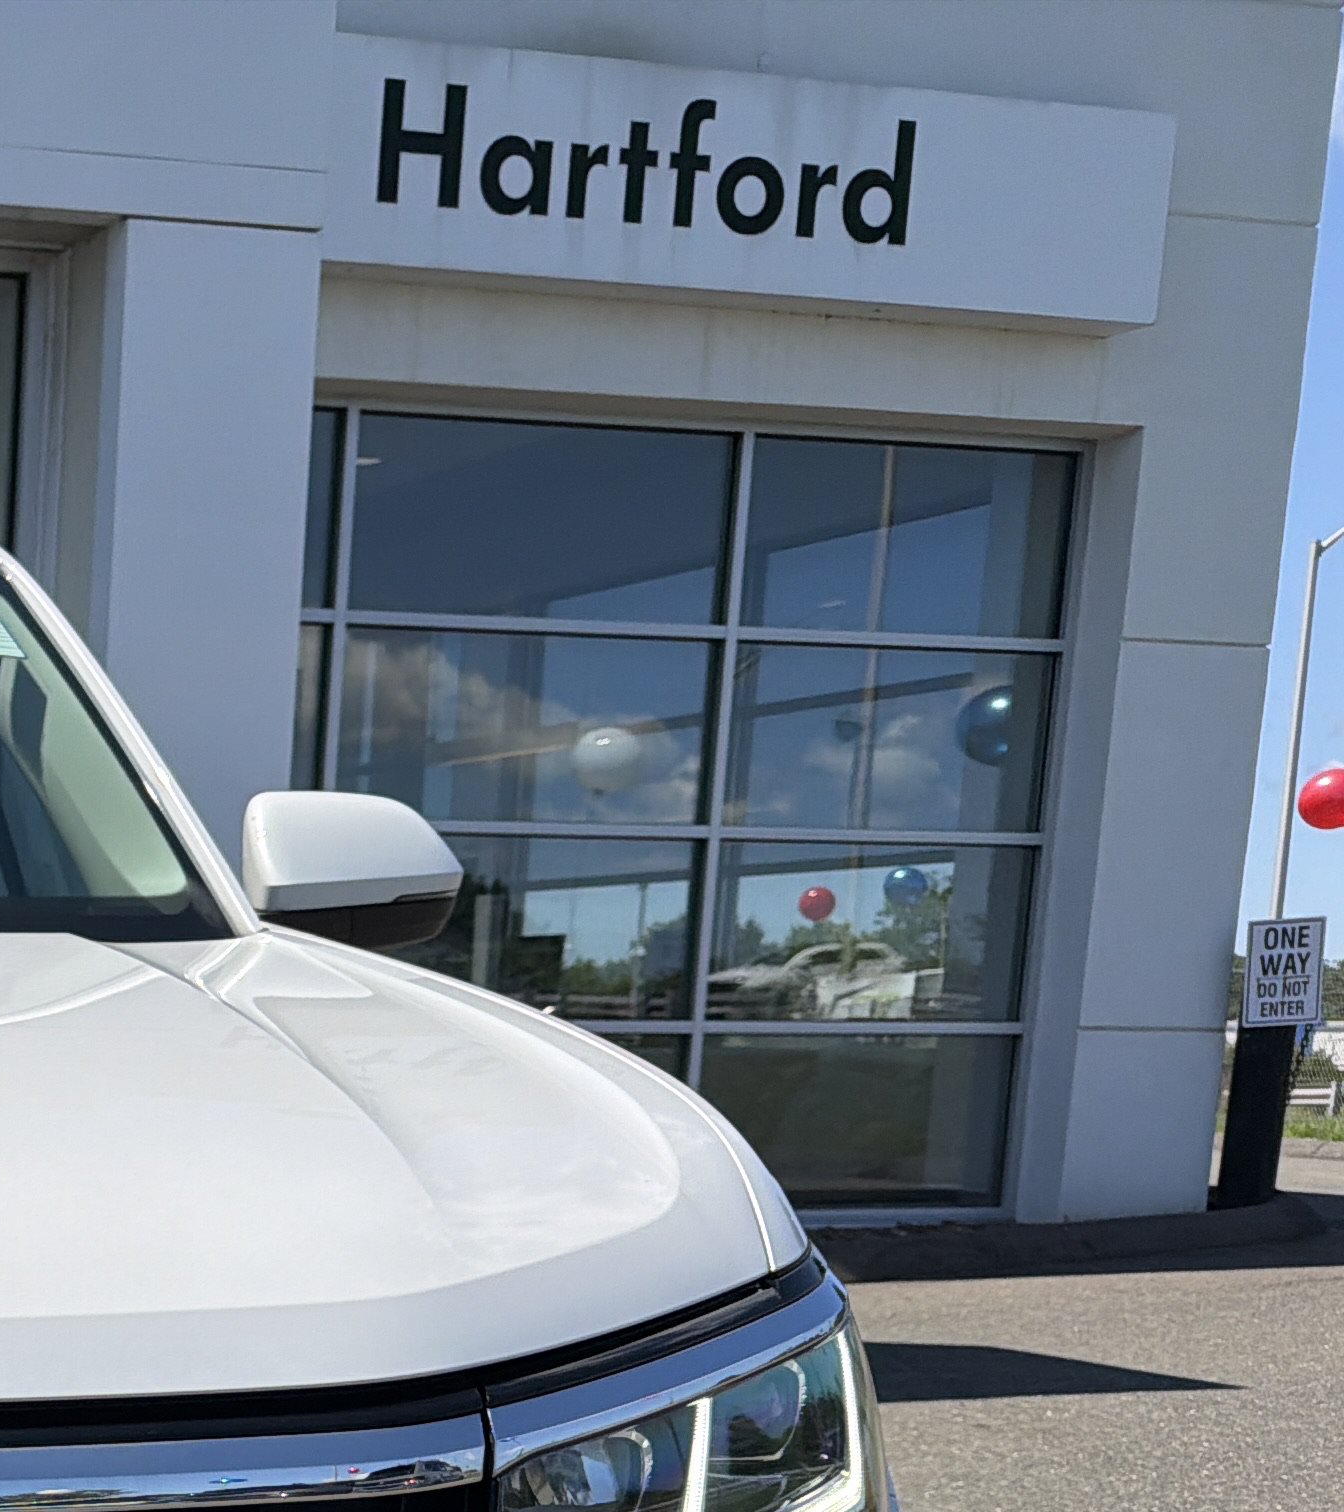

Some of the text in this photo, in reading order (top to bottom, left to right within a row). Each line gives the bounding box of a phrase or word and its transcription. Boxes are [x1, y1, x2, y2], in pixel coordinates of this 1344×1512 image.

[376, 79, 917, 246] Hartford
[1264, 926, 1310, 950] ONE
[1260, 952, 1311, 976] WAY
[1257, 979, 1310, 998] DO NOT
[1260, 1001, 1305, 1018] ENTER
